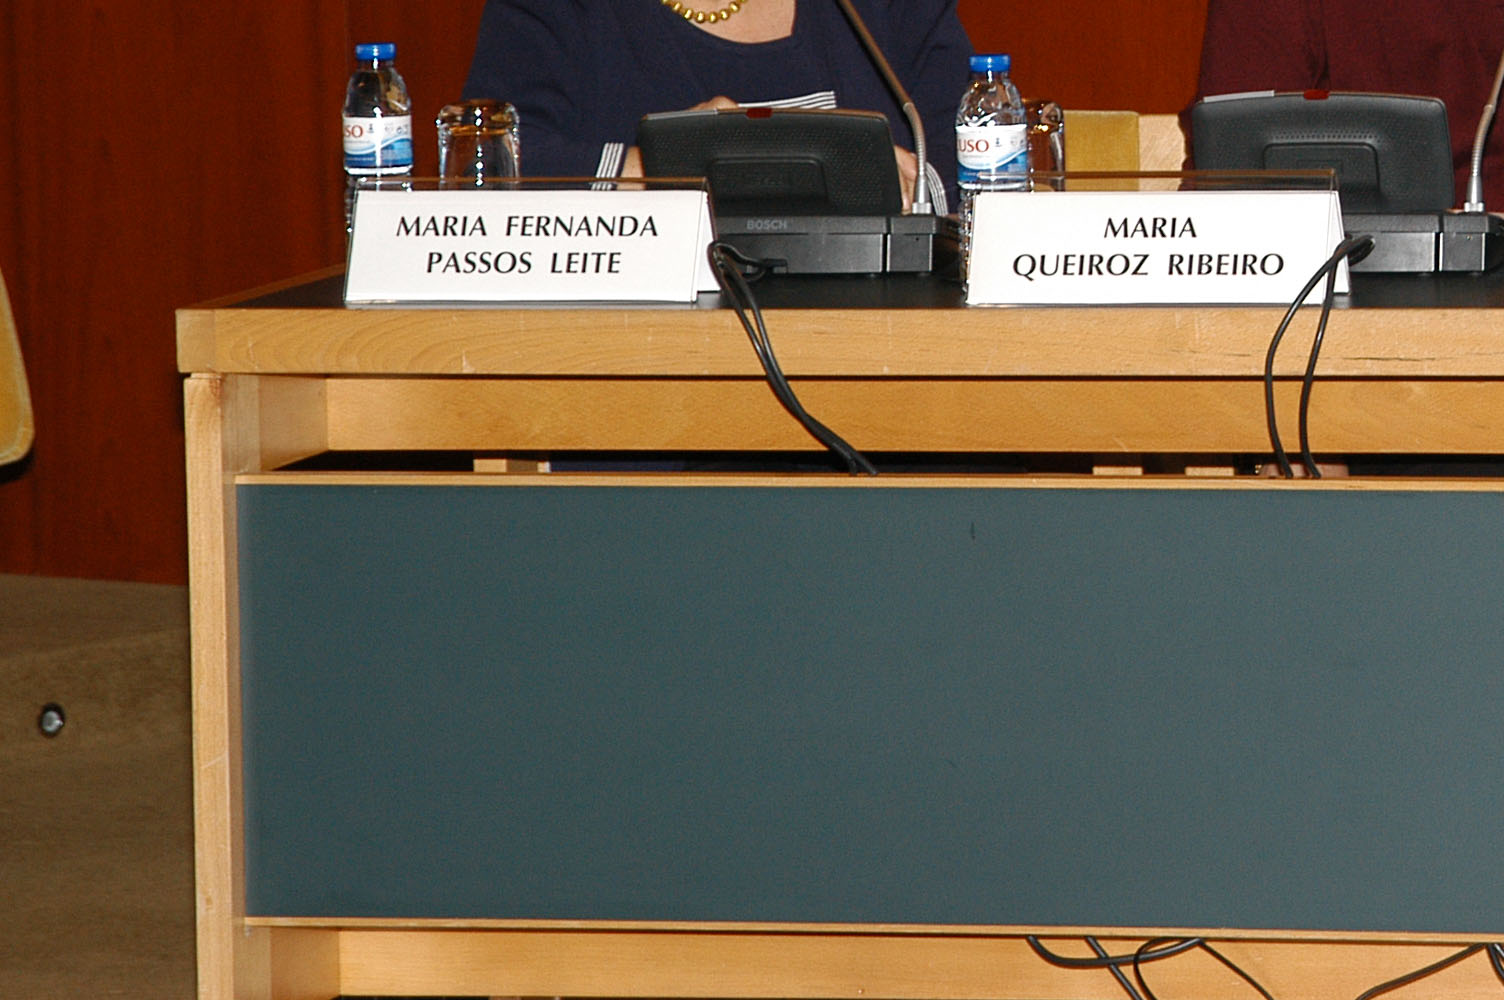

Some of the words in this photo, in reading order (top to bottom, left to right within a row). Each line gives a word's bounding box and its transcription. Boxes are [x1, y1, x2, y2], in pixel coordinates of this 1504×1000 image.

[396, 215, 487, 237] MARIA
[505, 215, 658, 237] FERNANDA
[746, 219, 788, 230] BOSCH
[1103, 217, 1197, 238] MARIA
[426, 251, 532, 274] PASSOS
[550, 252, 622, 274] LEITE
[1012, 253, 1150, 282] QUEIROZ
[1168, 253, 1284, 276] RIBEIRO
